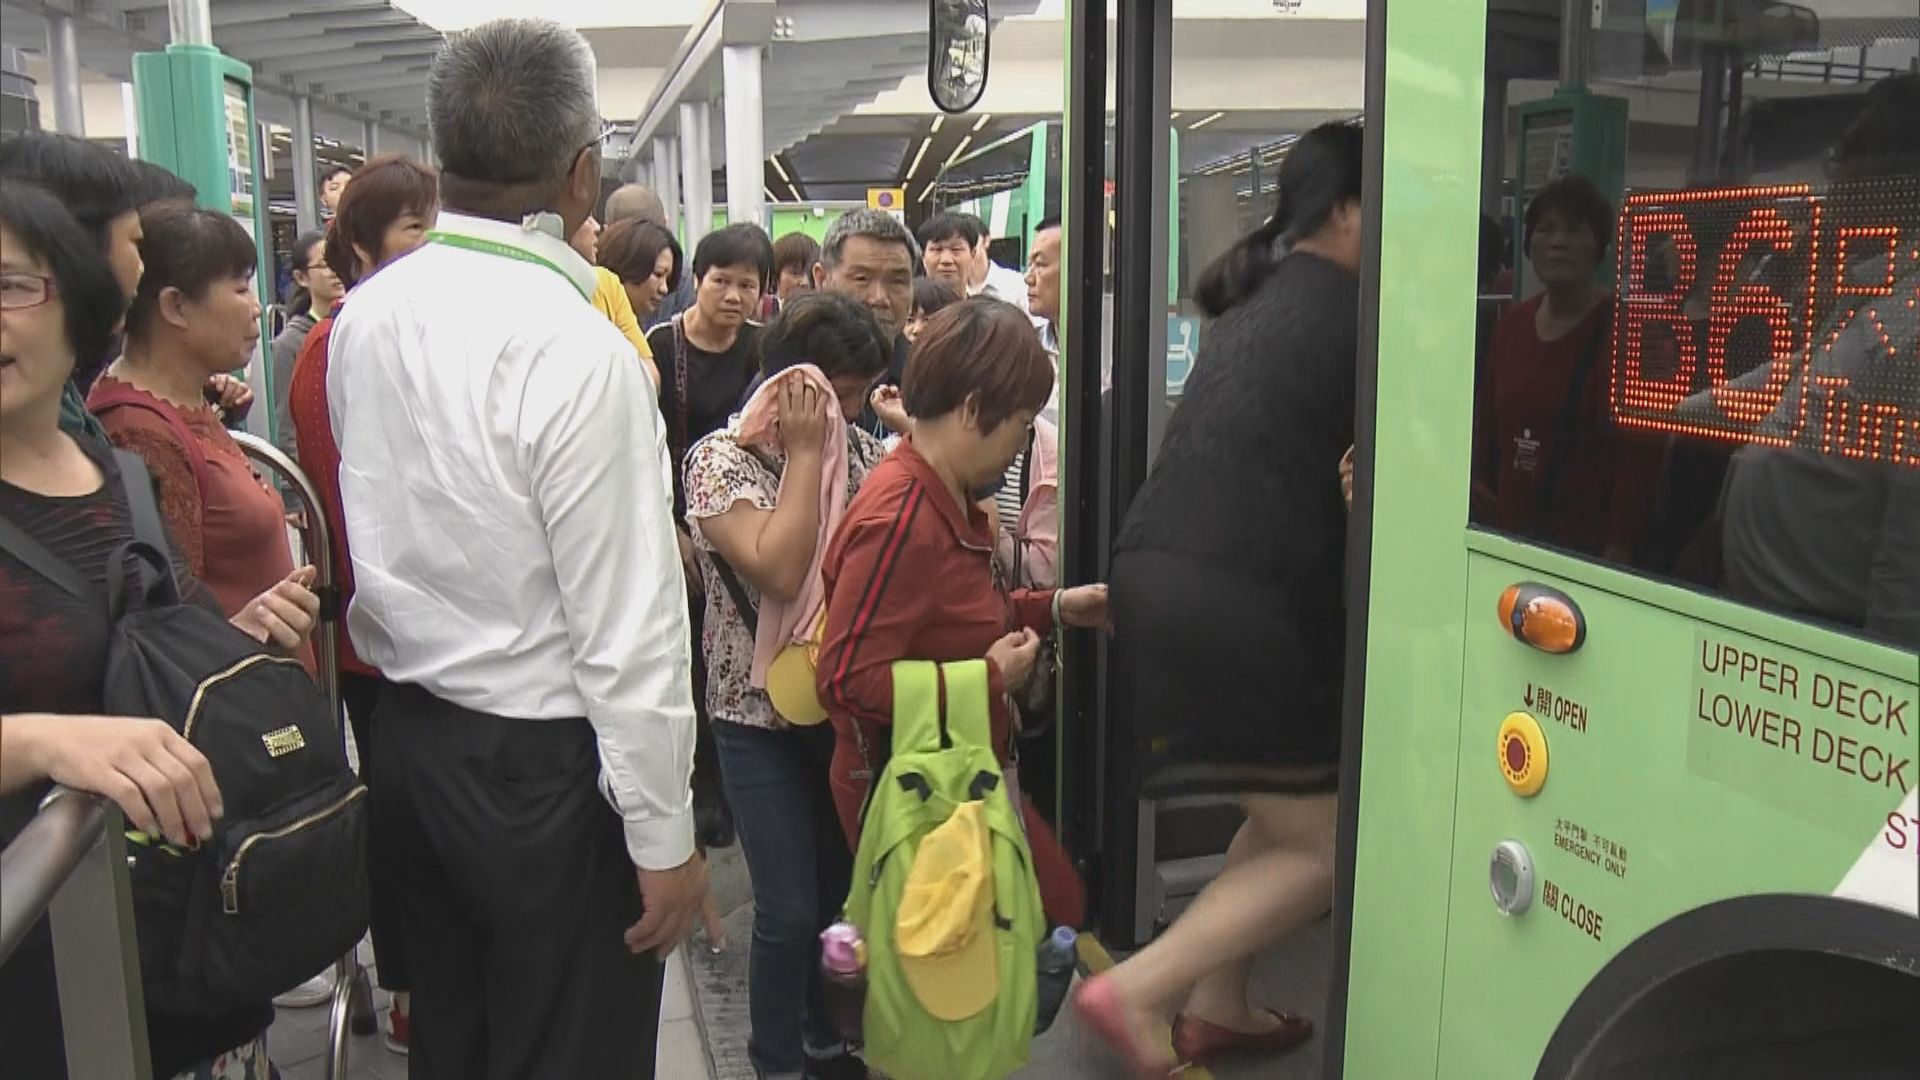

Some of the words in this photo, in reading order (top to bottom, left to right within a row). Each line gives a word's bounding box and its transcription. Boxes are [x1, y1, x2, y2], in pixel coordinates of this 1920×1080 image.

[1623, 207, 1793, 423] B6
[1814, 375, 1920, 465] Tun
[1536, 687, 1553, 718] 開
[1554, 695, 1588, 734] OPEN
[1702, 639, 1799, 700] UPPER
[1812, 673, 1910, 737] DECK
[1698, 687, 1801, 755] LOWER
[1812, 728, 1911, 795] DECK
[1554, 832, 1601, 866] EMERGENCY
[1605, 857, 1626, 879] ONLY
[1561, 893, 1604, 942] CLOSE
